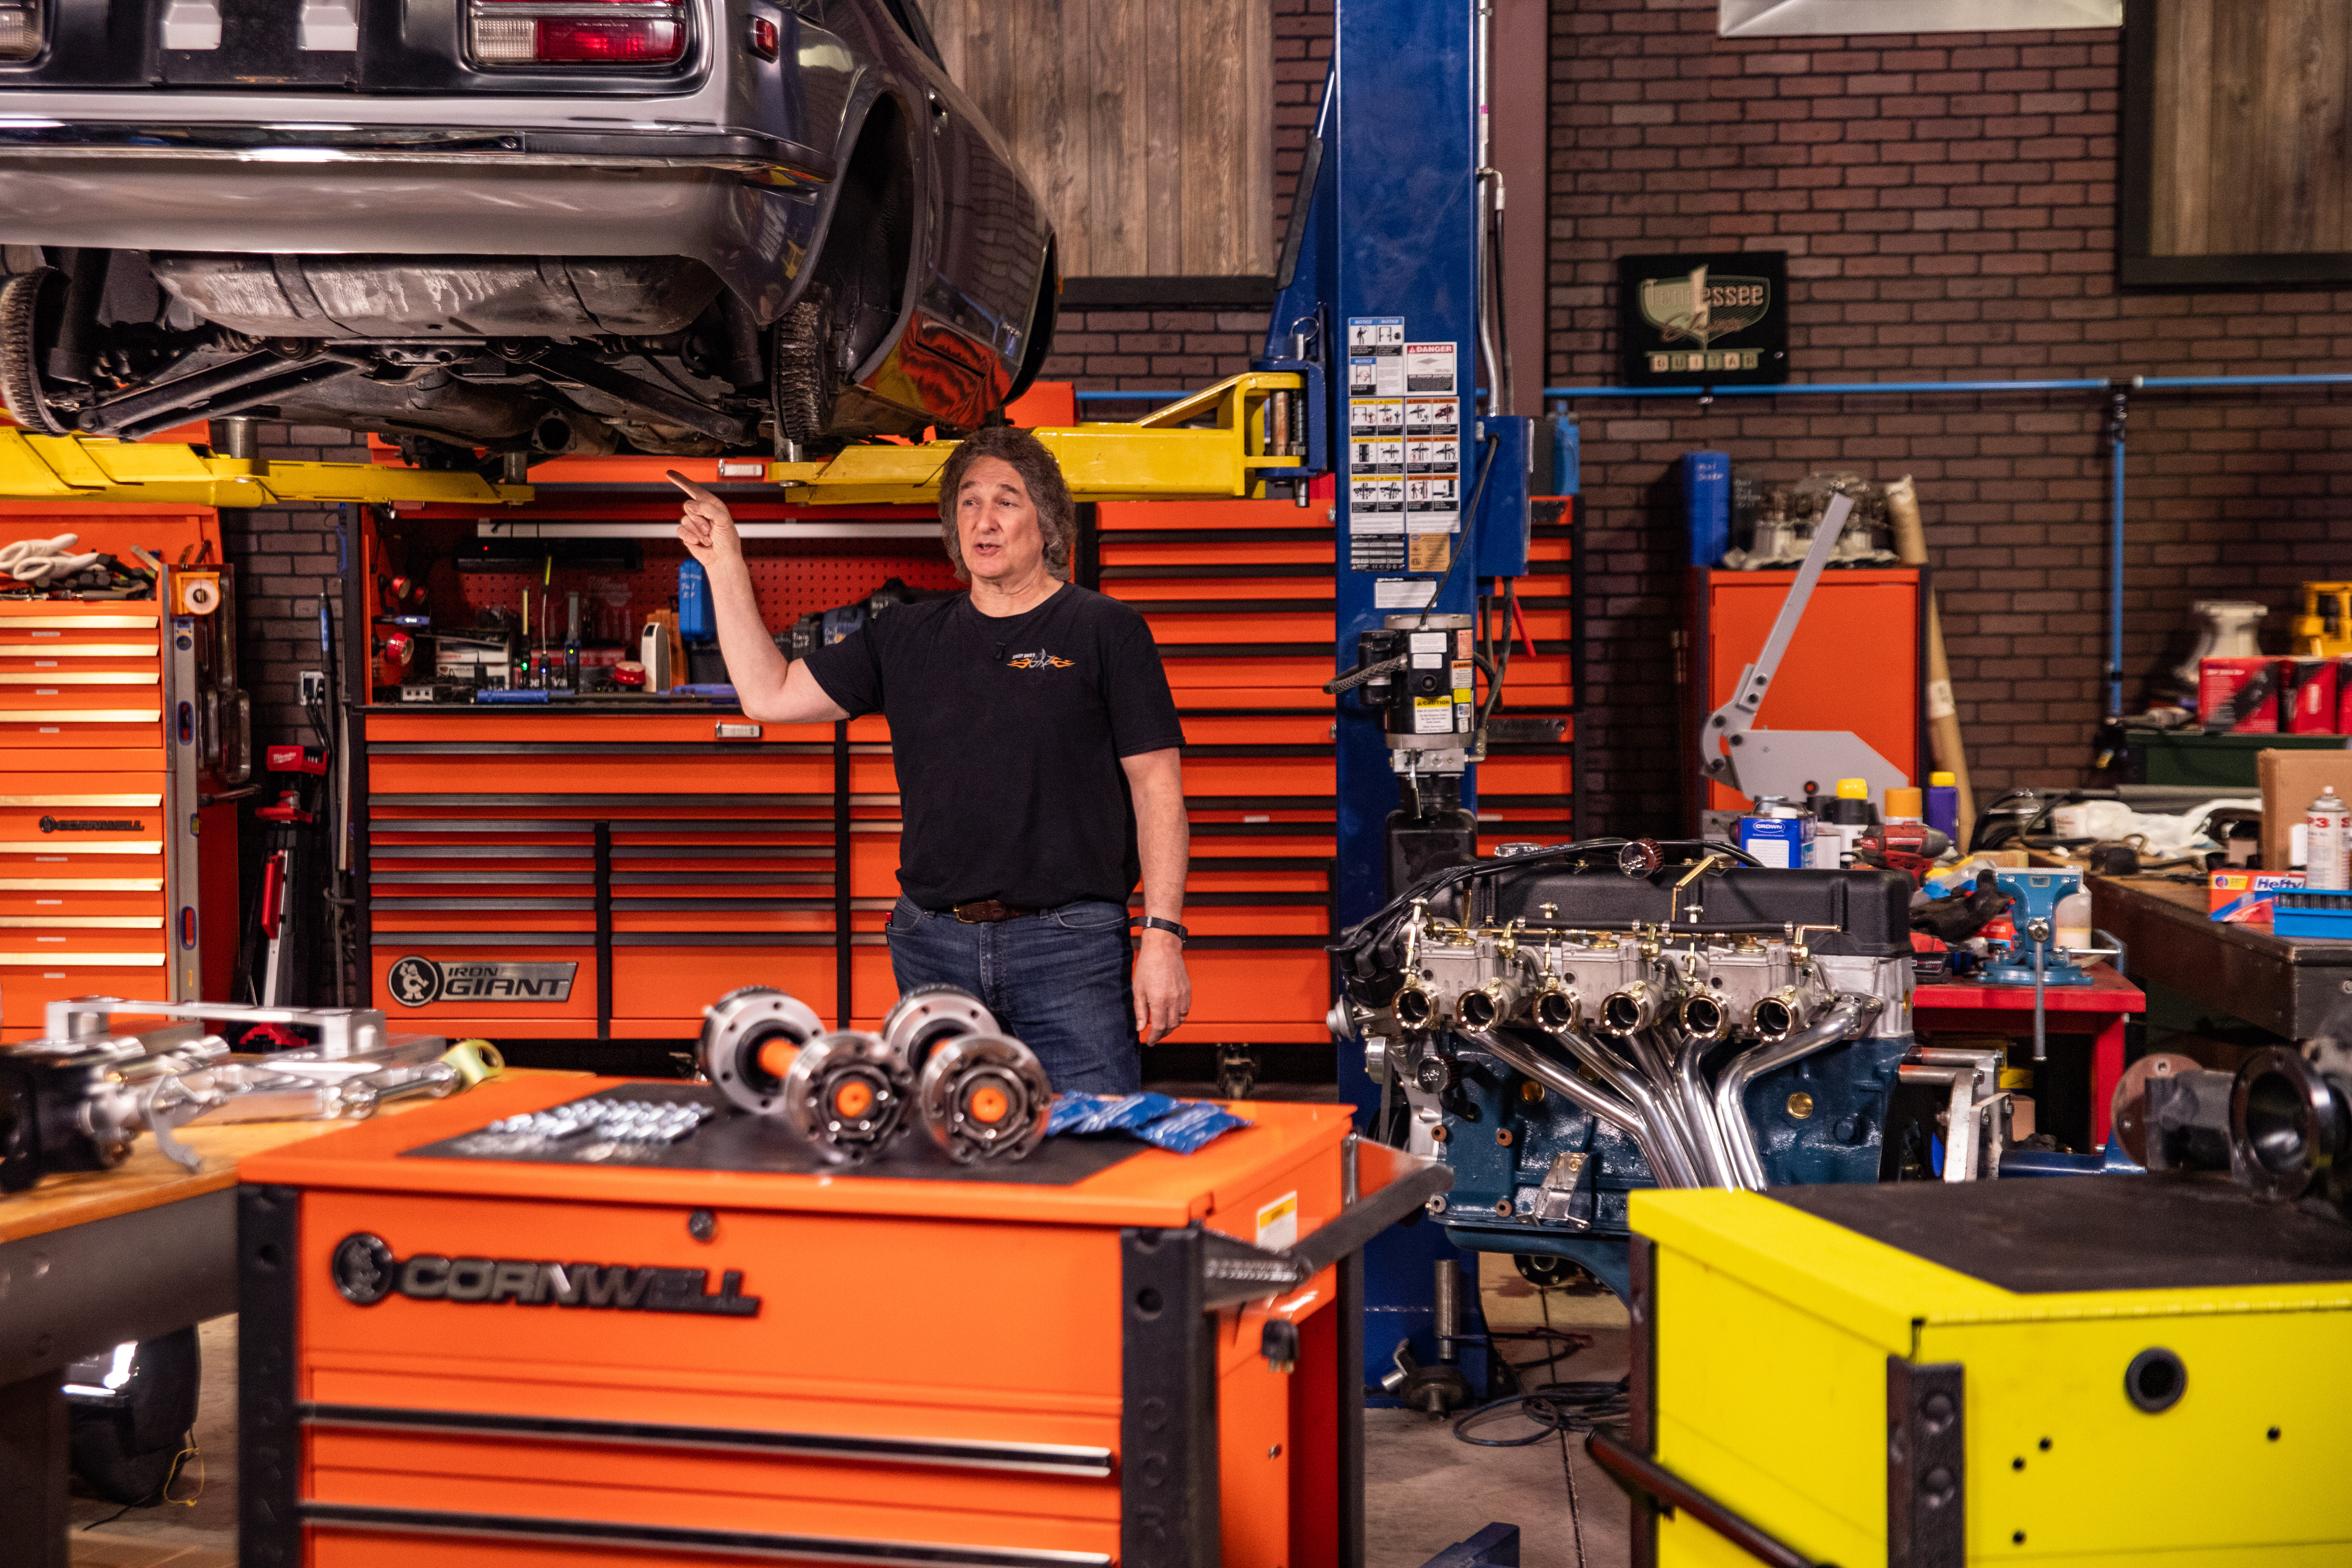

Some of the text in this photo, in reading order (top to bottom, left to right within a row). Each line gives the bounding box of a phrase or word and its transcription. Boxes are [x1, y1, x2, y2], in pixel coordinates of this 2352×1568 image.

[57, 820, 144, 831] CORNWELL
[448, 968, 498, 977] IRON
[445, 979, 570, 996] GIANT
[401, 1254, 761, 1317] CORNWELL
